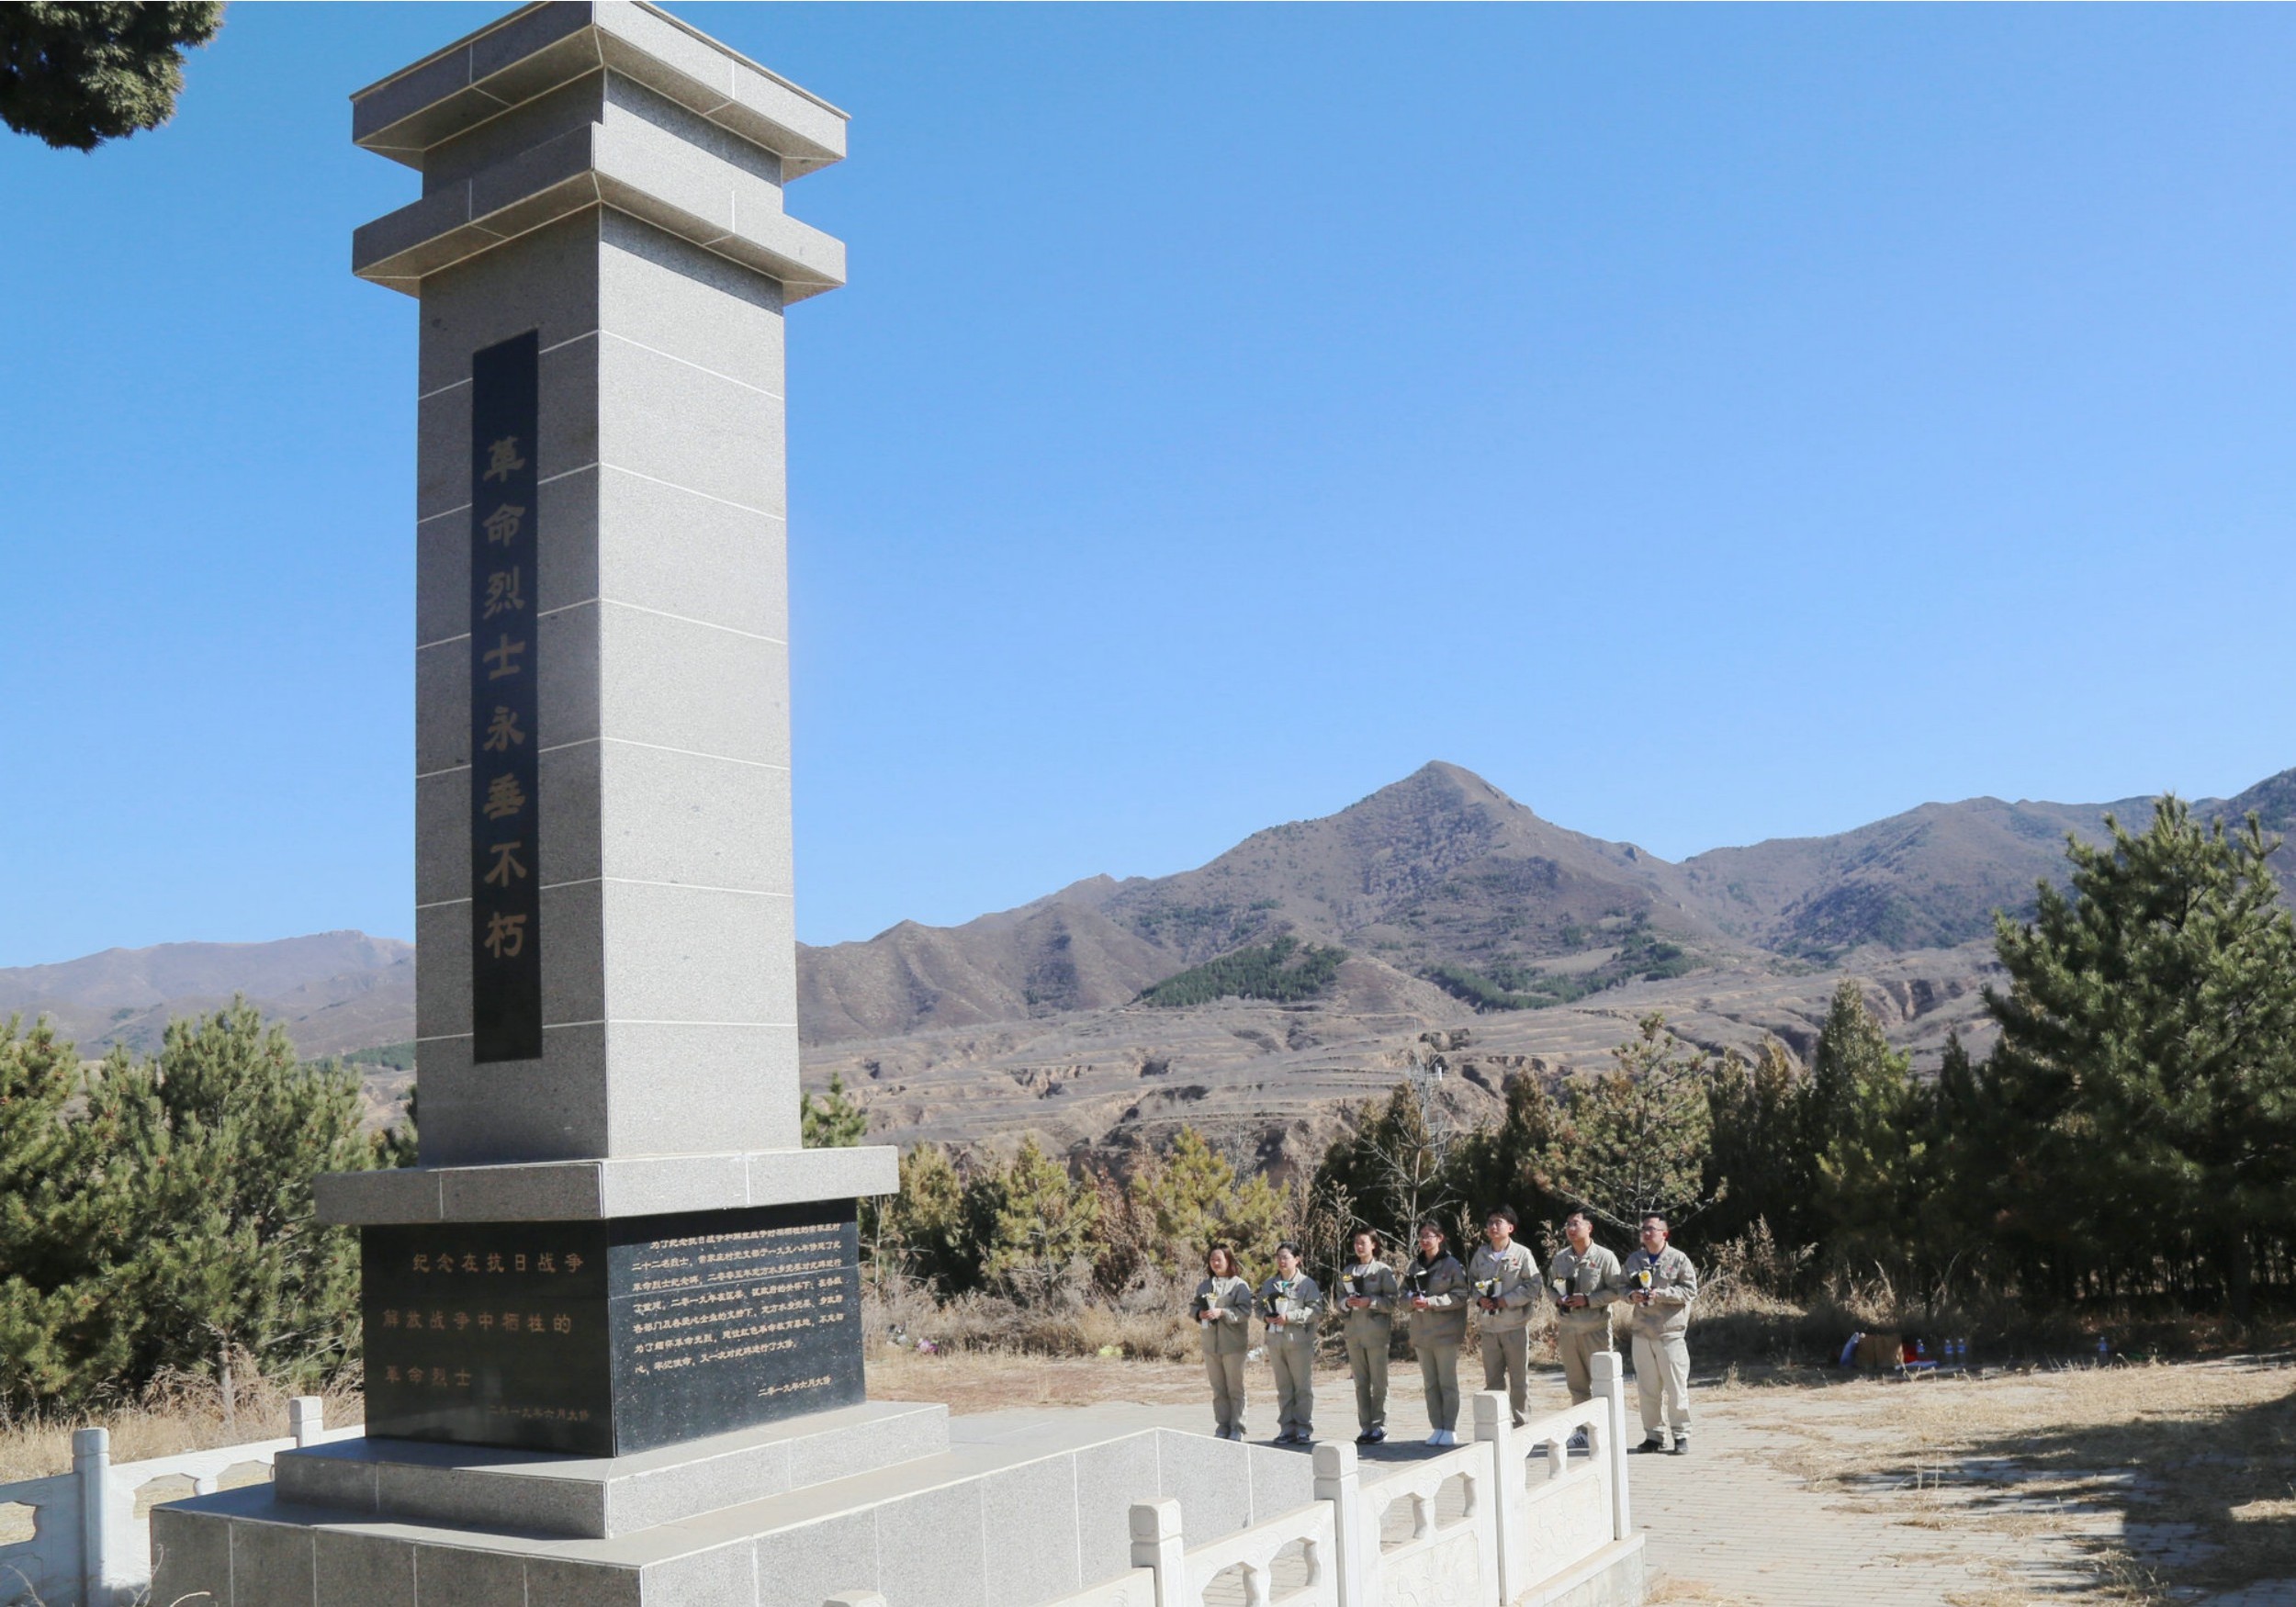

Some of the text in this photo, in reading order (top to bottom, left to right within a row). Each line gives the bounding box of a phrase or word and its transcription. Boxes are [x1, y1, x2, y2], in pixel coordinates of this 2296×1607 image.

[481, 435, 526, 960] 革命烈士永垂不朽
[413, 1253, 583, 1274] 纪念在抗日战争
[383, 1309, 572, 1334] 解放战争中牺牲的
[386, 1365, 472, 1388] 革命烈士
